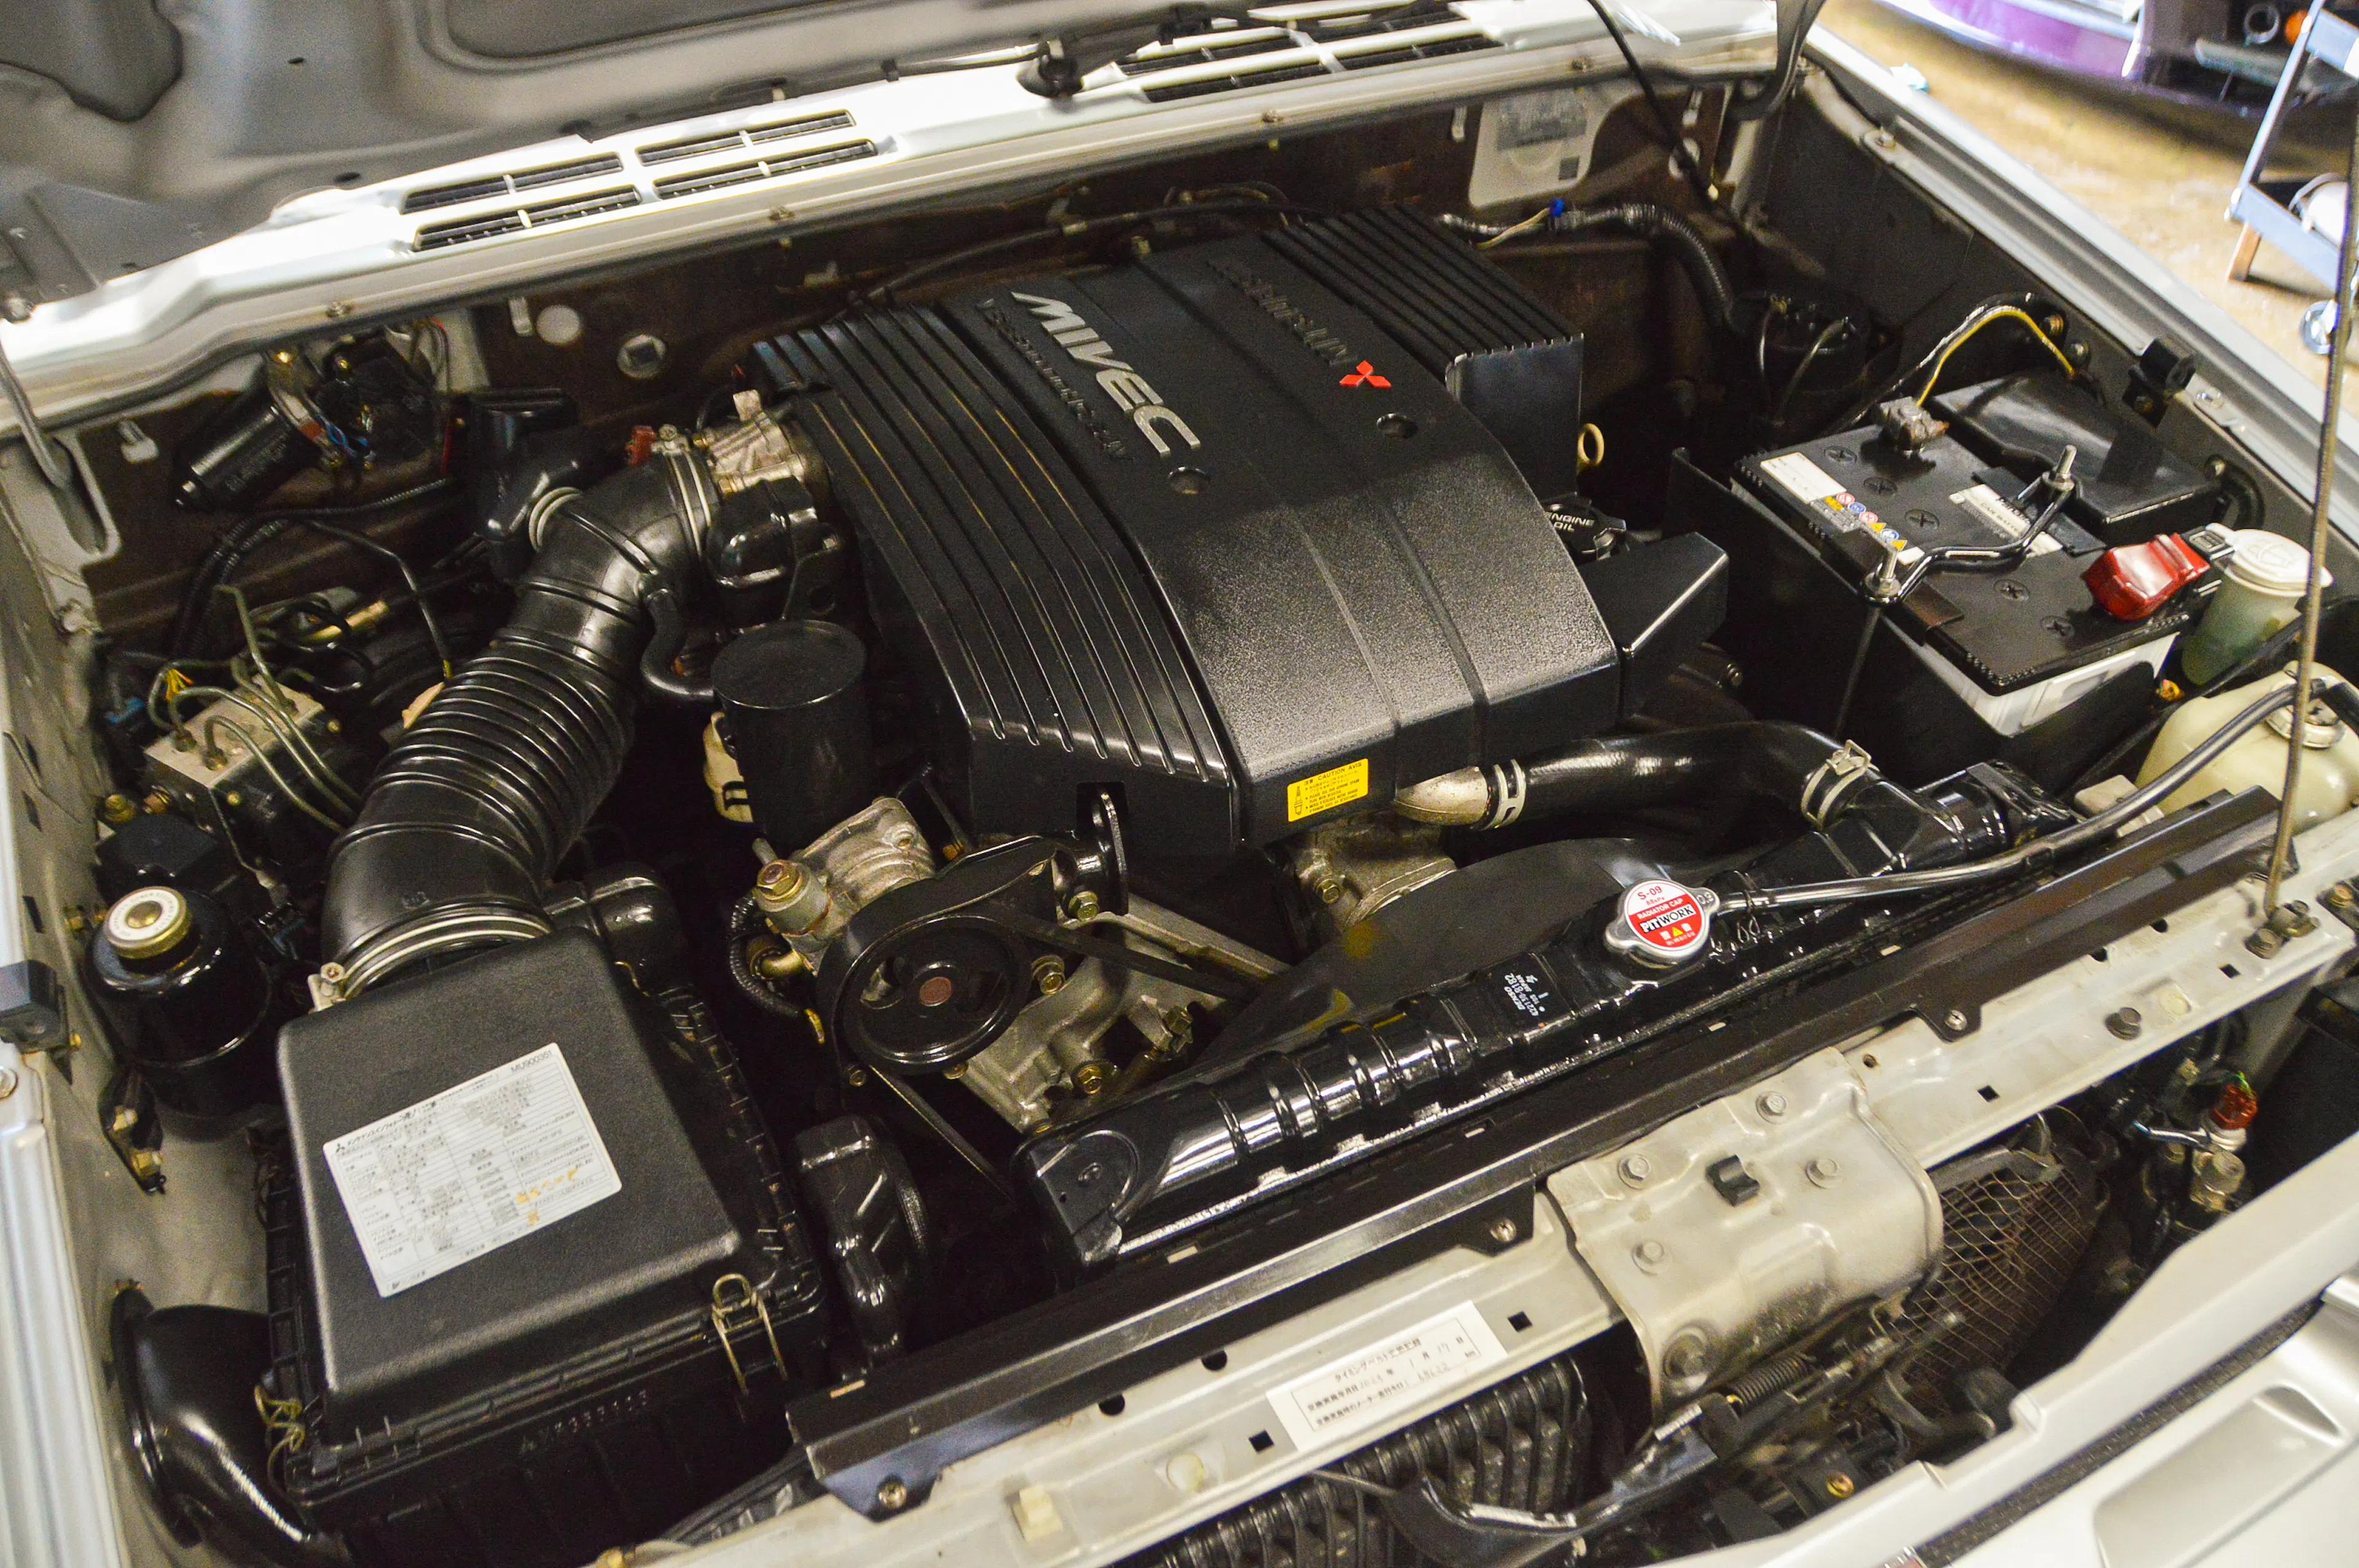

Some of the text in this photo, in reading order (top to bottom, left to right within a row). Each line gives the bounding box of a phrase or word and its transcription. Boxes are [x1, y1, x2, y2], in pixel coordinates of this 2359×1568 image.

[1011, 291, 1201, 457] MIVEC
[1554, 521, 1575, 532] OIL
[1318, 768, 1345, 780] CAUTION
[1637, 886, 1662, 900] S-09
[1637, 898, 1683, 919] RADIATOR CAP
[1640, 906, 1694, 933] PITWORK
[1516, 975, 1532, 992] JAPAN
[1504, 986, 1525, 1010] DENSO
